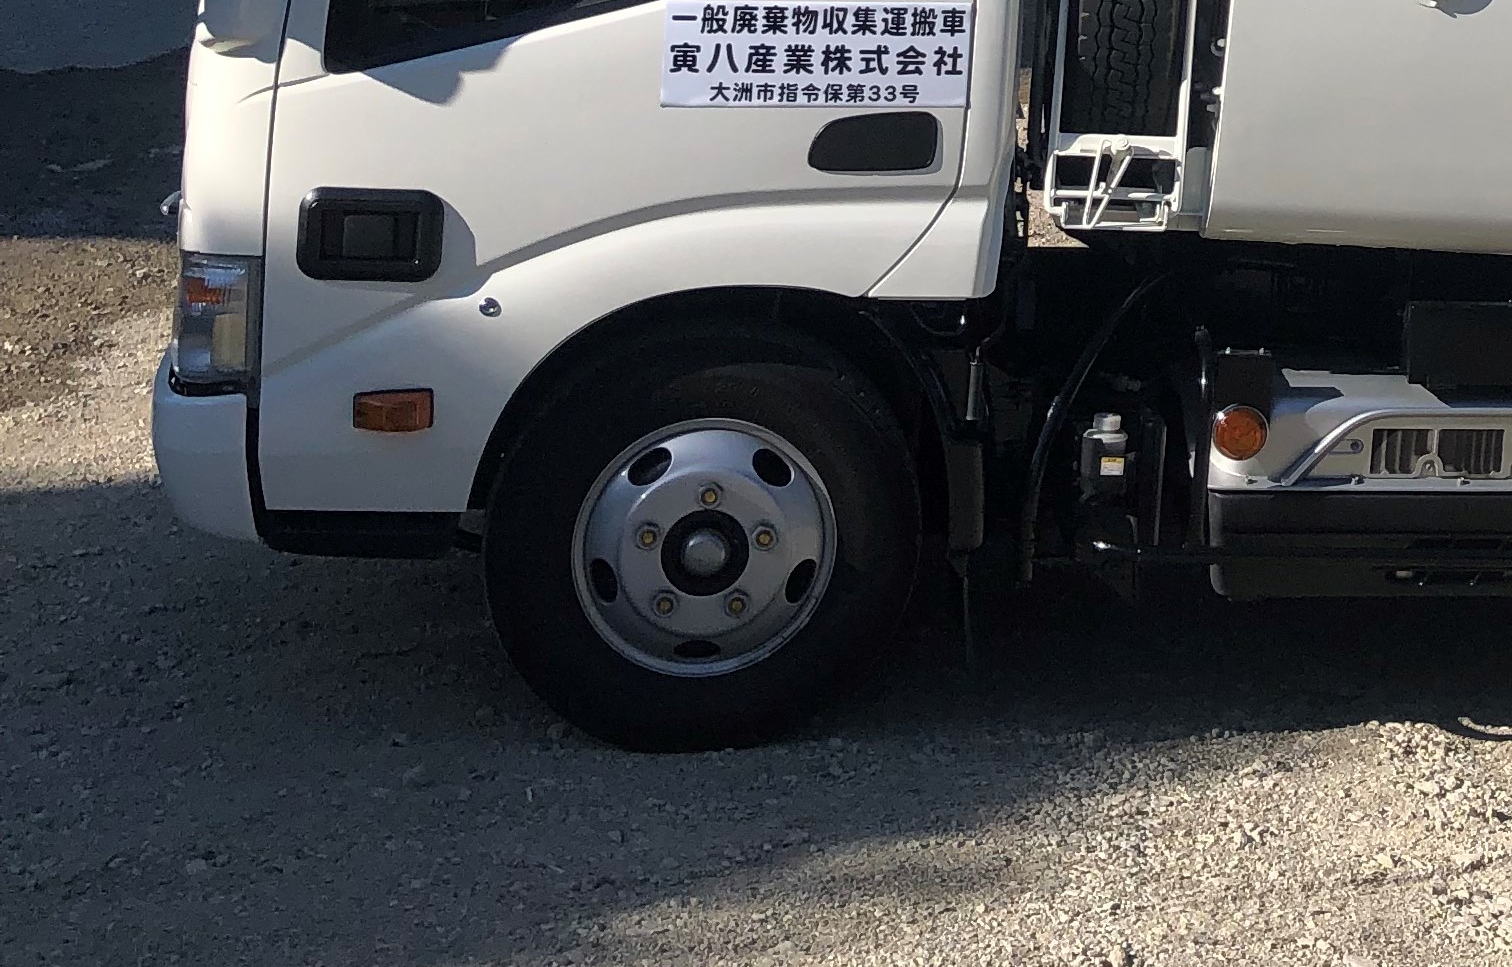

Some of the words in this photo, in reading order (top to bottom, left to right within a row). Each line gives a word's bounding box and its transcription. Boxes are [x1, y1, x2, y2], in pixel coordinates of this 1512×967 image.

[671, 4, 967, 37] 一般廃棄物収集運搬車
[669, 42, 963, 76] 寅八産業株式会社
[709, 82, 920, 104] 大洲市指令保第33号
